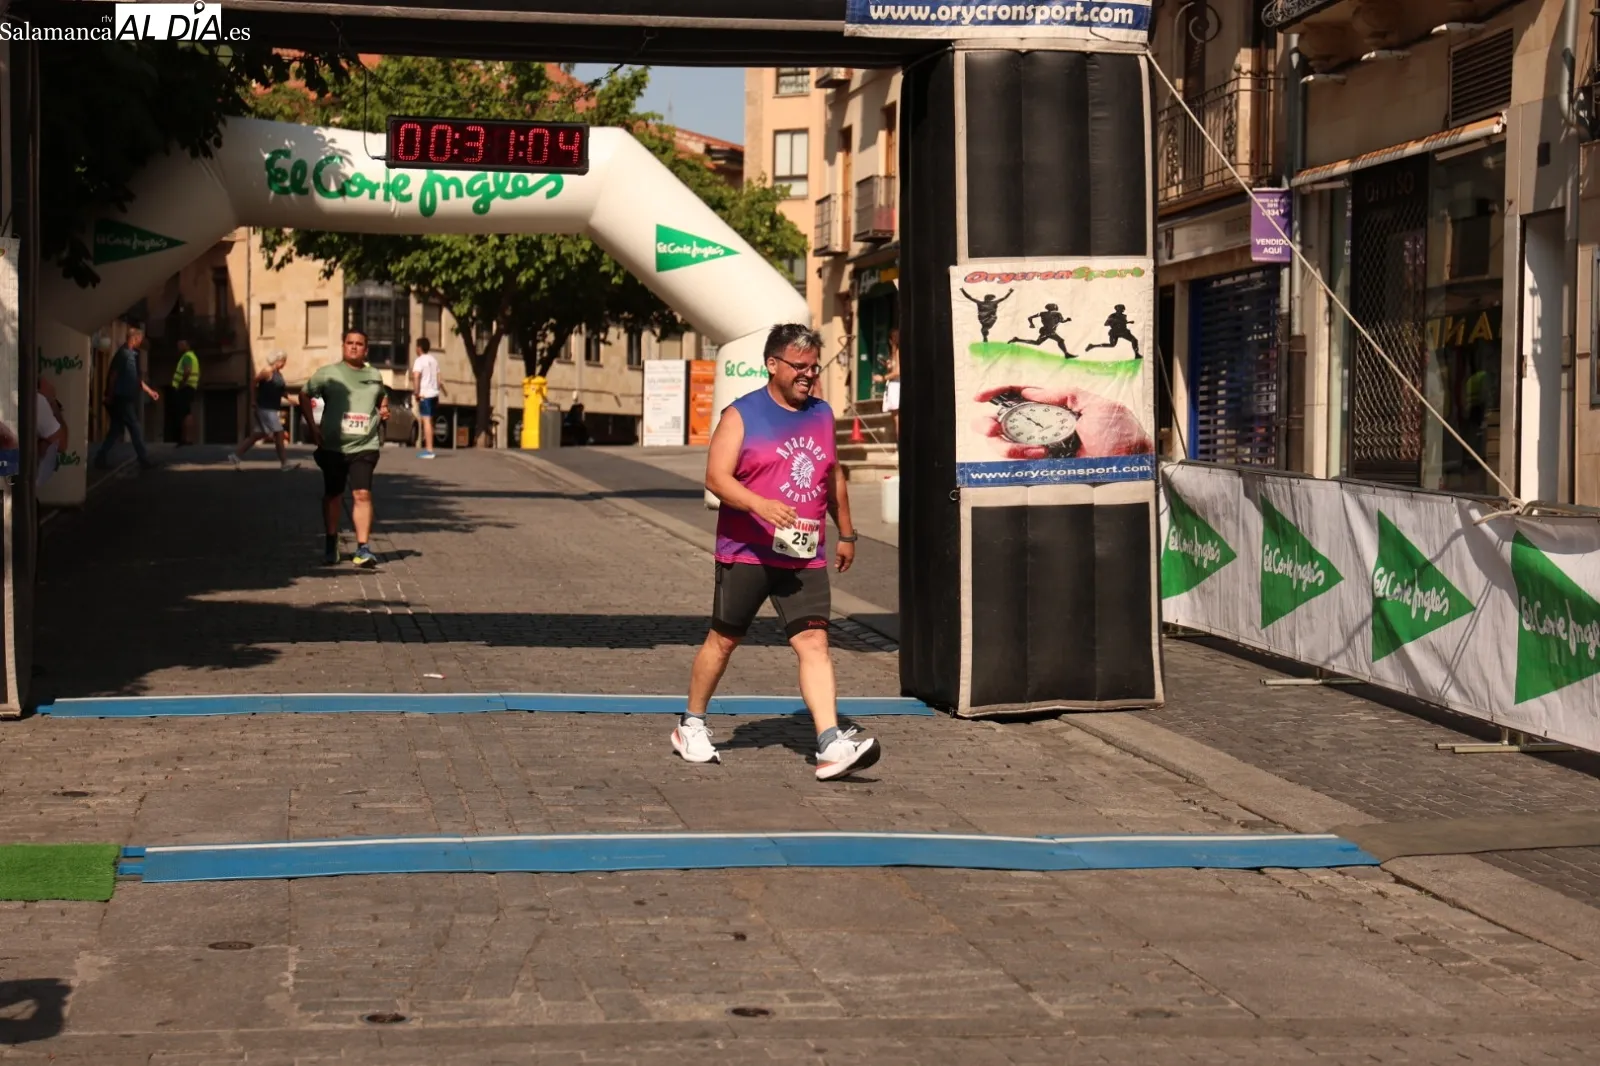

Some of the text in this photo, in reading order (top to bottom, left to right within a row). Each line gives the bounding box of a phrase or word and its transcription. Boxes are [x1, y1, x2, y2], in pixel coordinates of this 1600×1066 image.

[870, 3, 1134, 25] www.orycronsport.com
[265, 148, 309, 196] El
[313, 155, 413, 203] Corte
[1263, 246, 1283, 255] AQUÍ
[725, 360, 736, 377] El
[349, 420, 364, 428] 231
[776, 436, 827, 461] Apaches
[971, 464, 1152, 479] www.orycronsport.com
[792, 531, 809, 546] 25
[1168, 525, 1179, 551] El
[1193, 526, 1221, 569] Inglés
[1263, 544, 1325, 592] El Corte Inglés
[1373, 566, 1450, 622] El Corte Inglés
[1521, 595, 1536, 632] El
[1534, 600, 1568, 641] Corte
